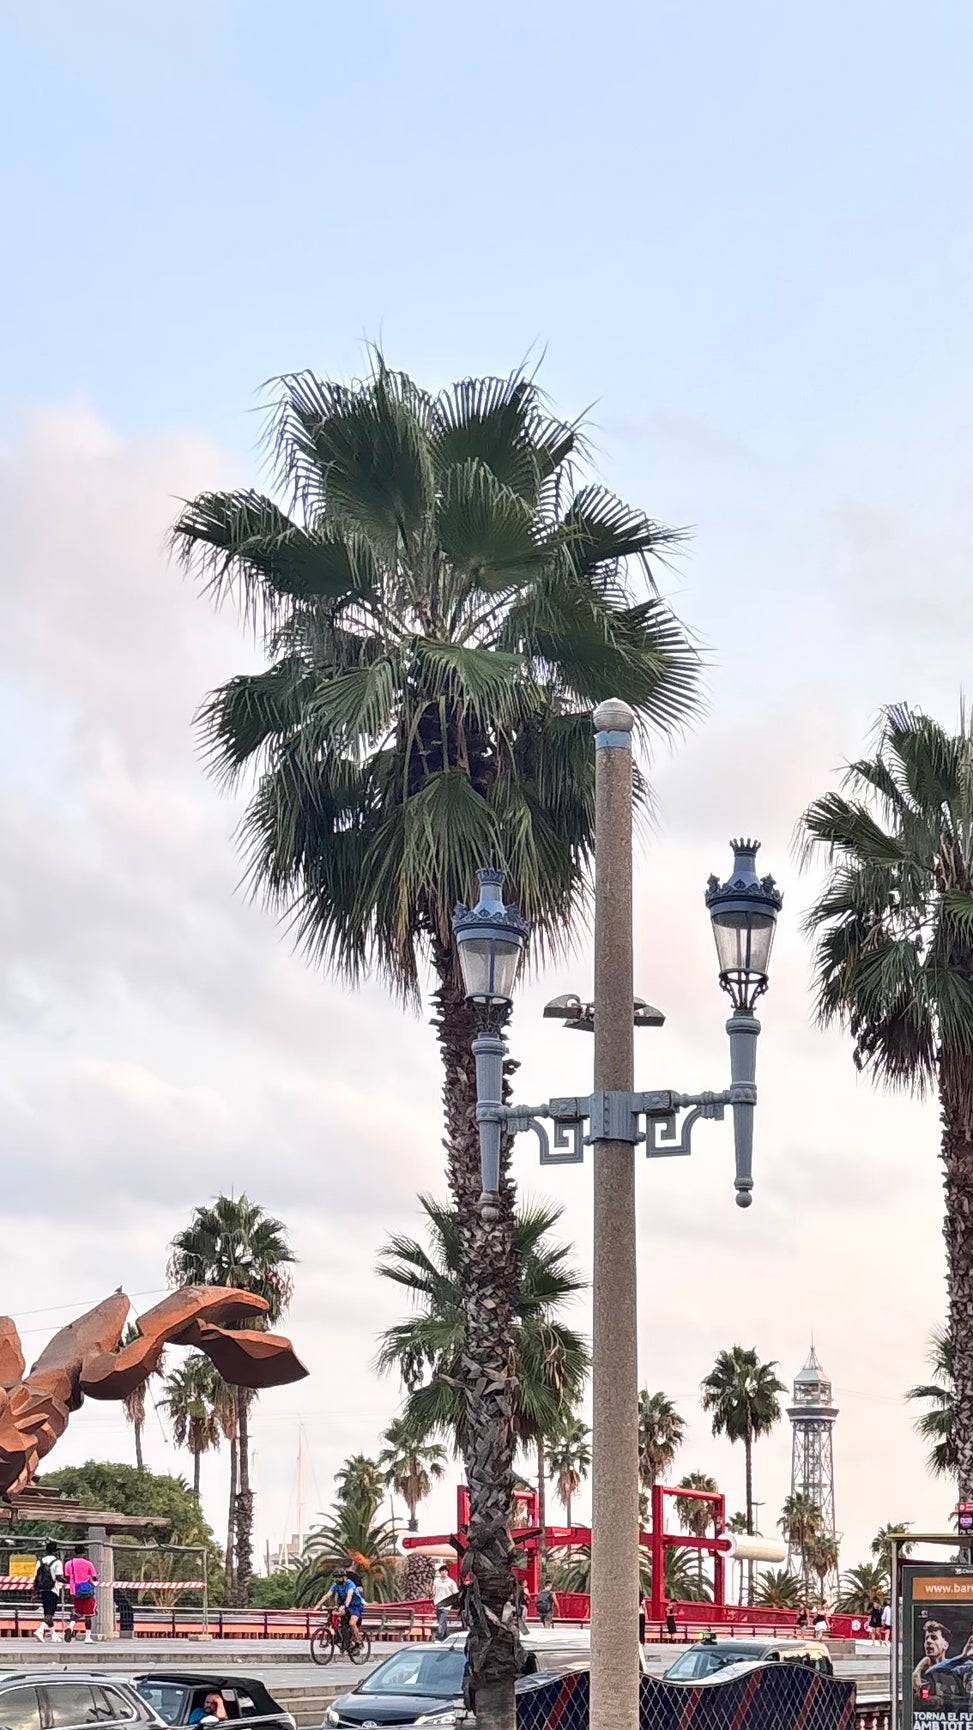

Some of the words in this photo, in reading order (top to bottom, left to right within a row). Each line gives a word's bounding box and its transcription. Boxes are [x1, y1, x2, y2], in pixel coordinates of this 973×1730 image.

[913, 1712, 946, 1721] TORNA
[947, 1712, 958, 1721] EL
[913, 1721, 940, 1730] AMB
[940, 1721, 964, 1730] TOT
